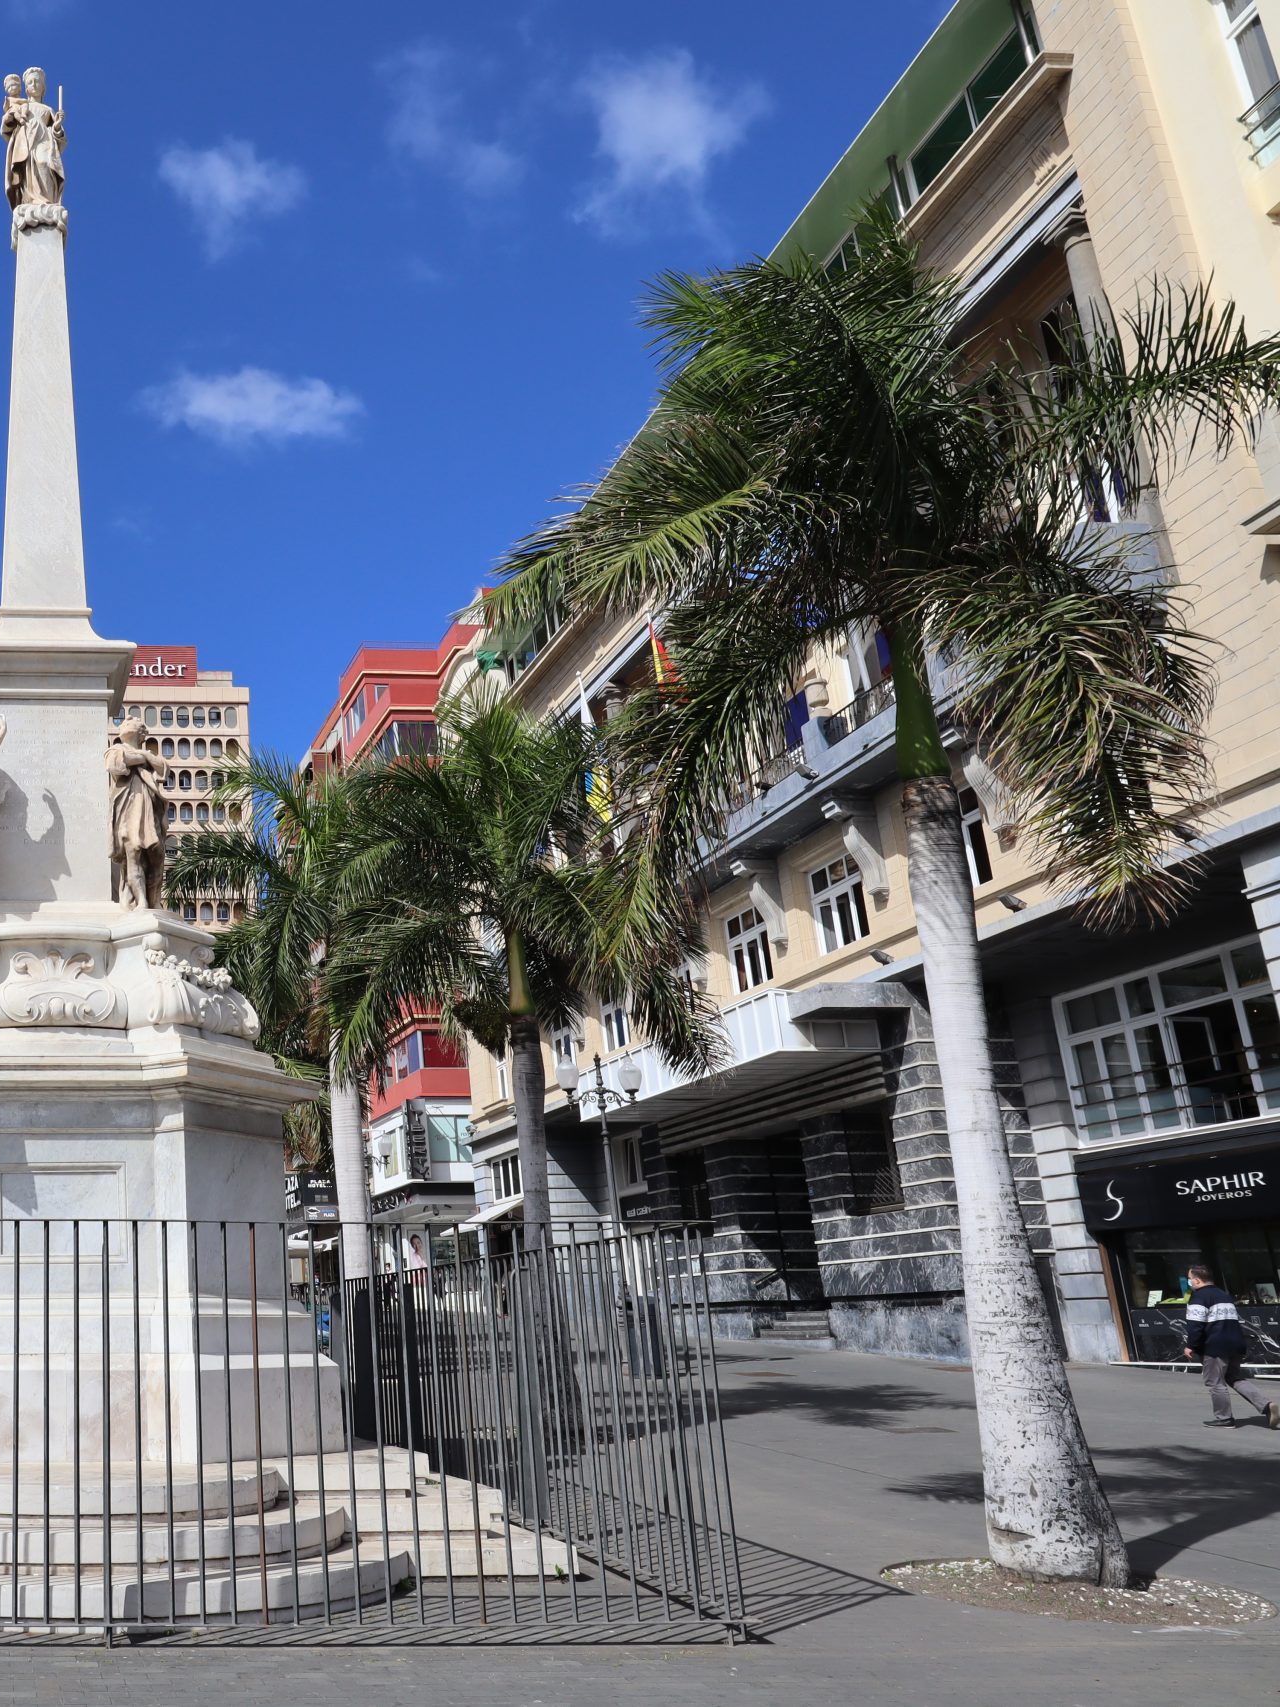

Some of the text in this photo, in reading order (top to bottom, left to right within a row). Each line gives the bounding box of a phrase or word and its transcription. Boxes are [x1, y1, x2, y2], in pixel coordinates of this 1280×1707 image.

[130, 656, 186, 677] nder
[1175, 1171, 1267, 1196] SAPHIR
[1195, 1189, 1253, 1203] JOYEROS
